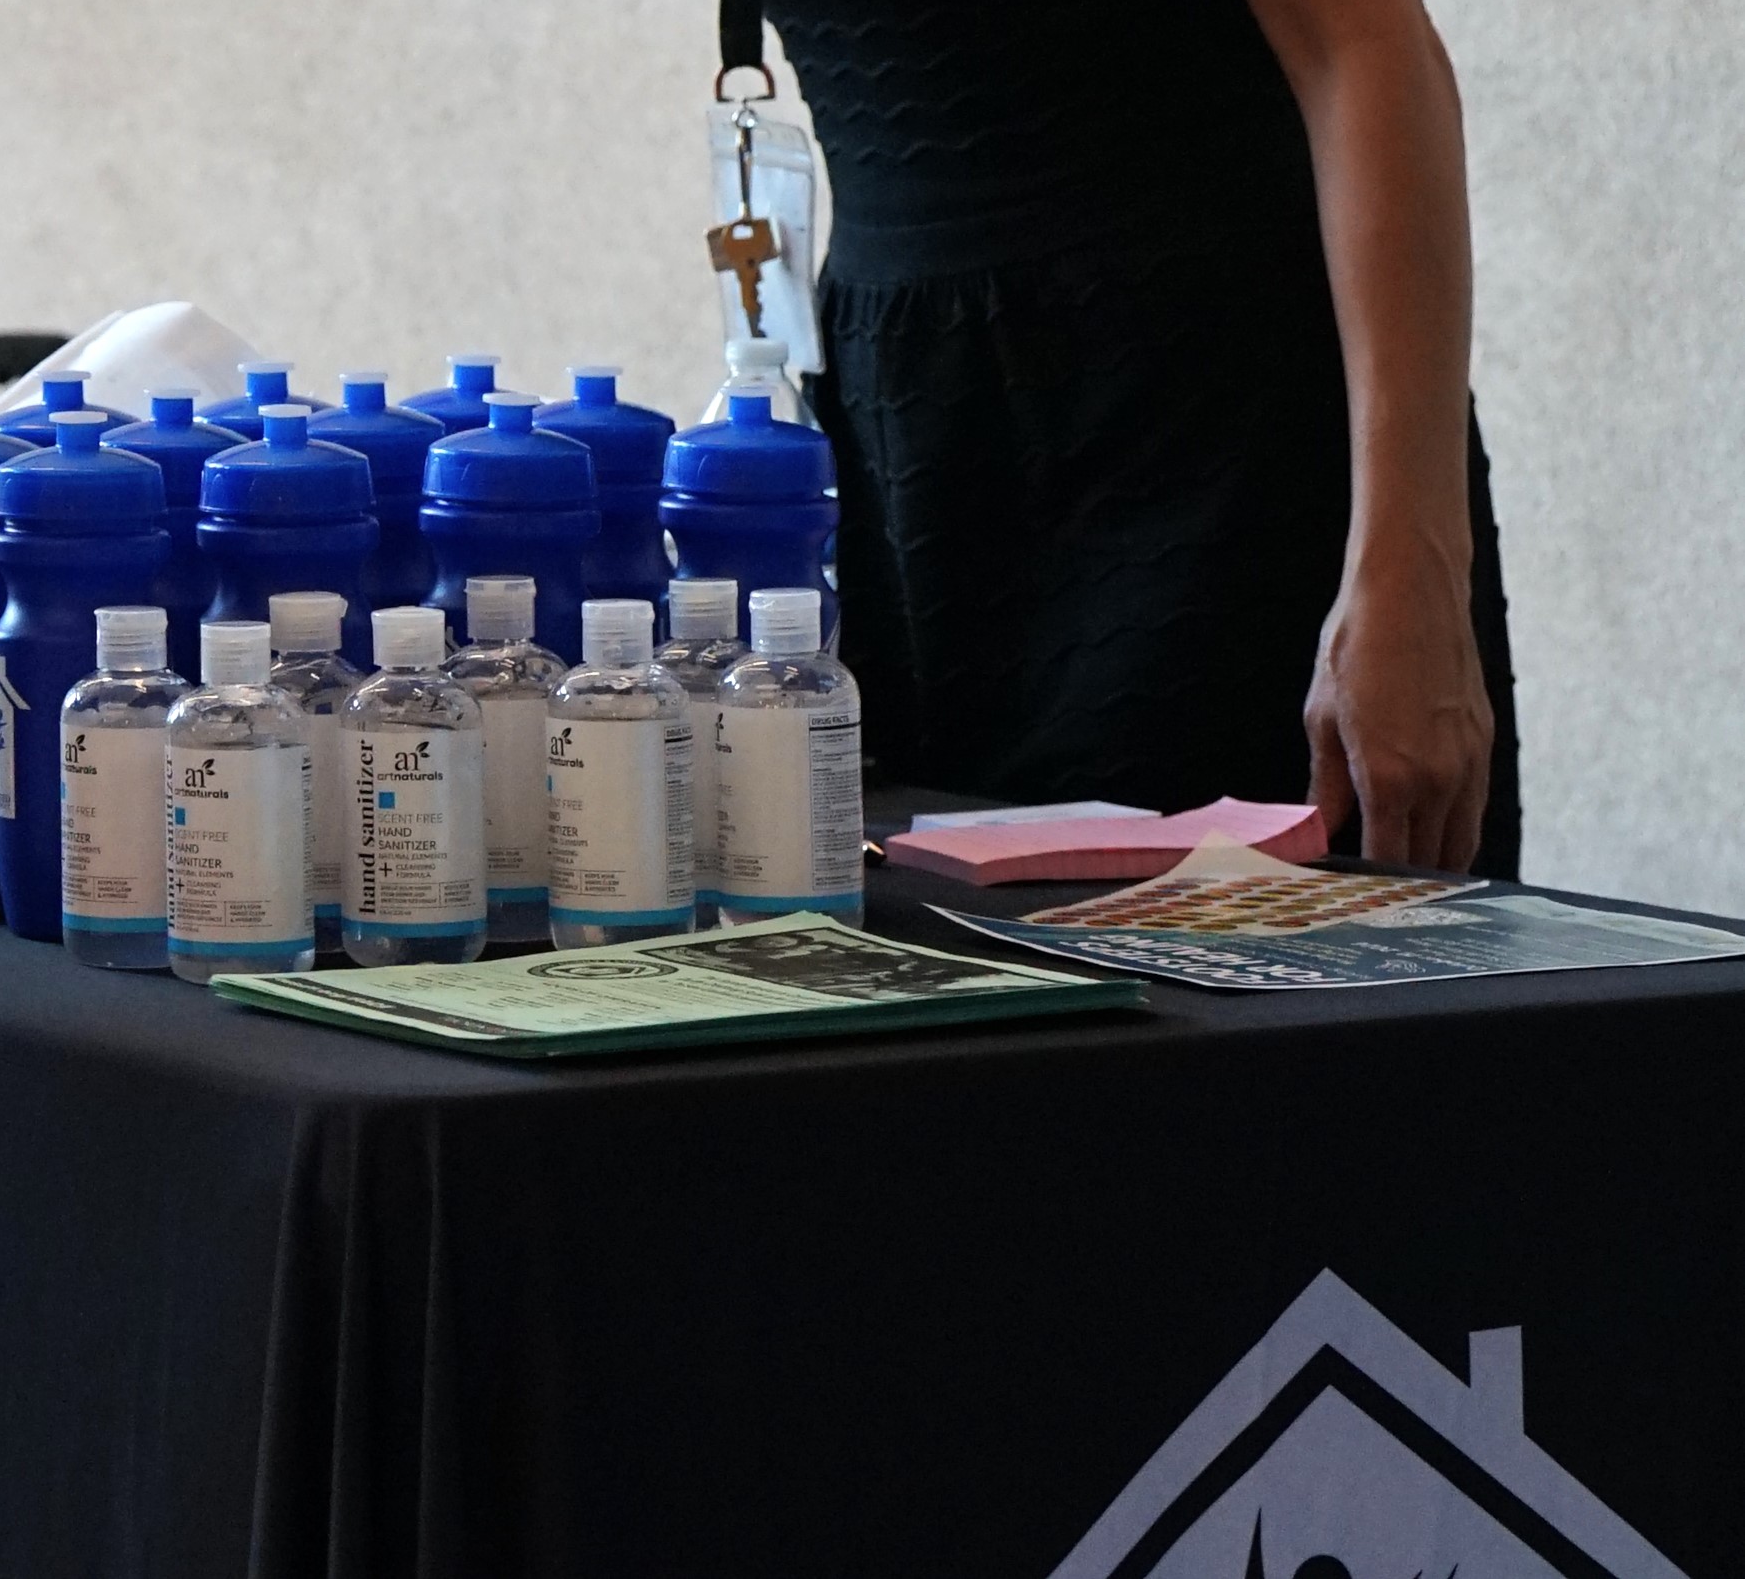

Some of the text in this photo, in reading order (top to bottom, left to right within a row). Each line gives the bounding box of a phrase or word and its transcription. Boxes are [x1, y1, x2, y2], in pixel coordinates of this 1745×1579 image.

[377, 771, 444, 782] artnaturals
[174, 788, 229, 800] artnaturals
[416, 812, 444, 824] FREE
[356, 739, 376, 914] hand sanitizer
[378, 826, 413, 838] HAND
[202, 830, 229, 843] FREE
[175, 842, 200, 854] HAND
[378, 839, 437, 851] SANITIZER
[175, 856, 222, 869] SANITIZER
